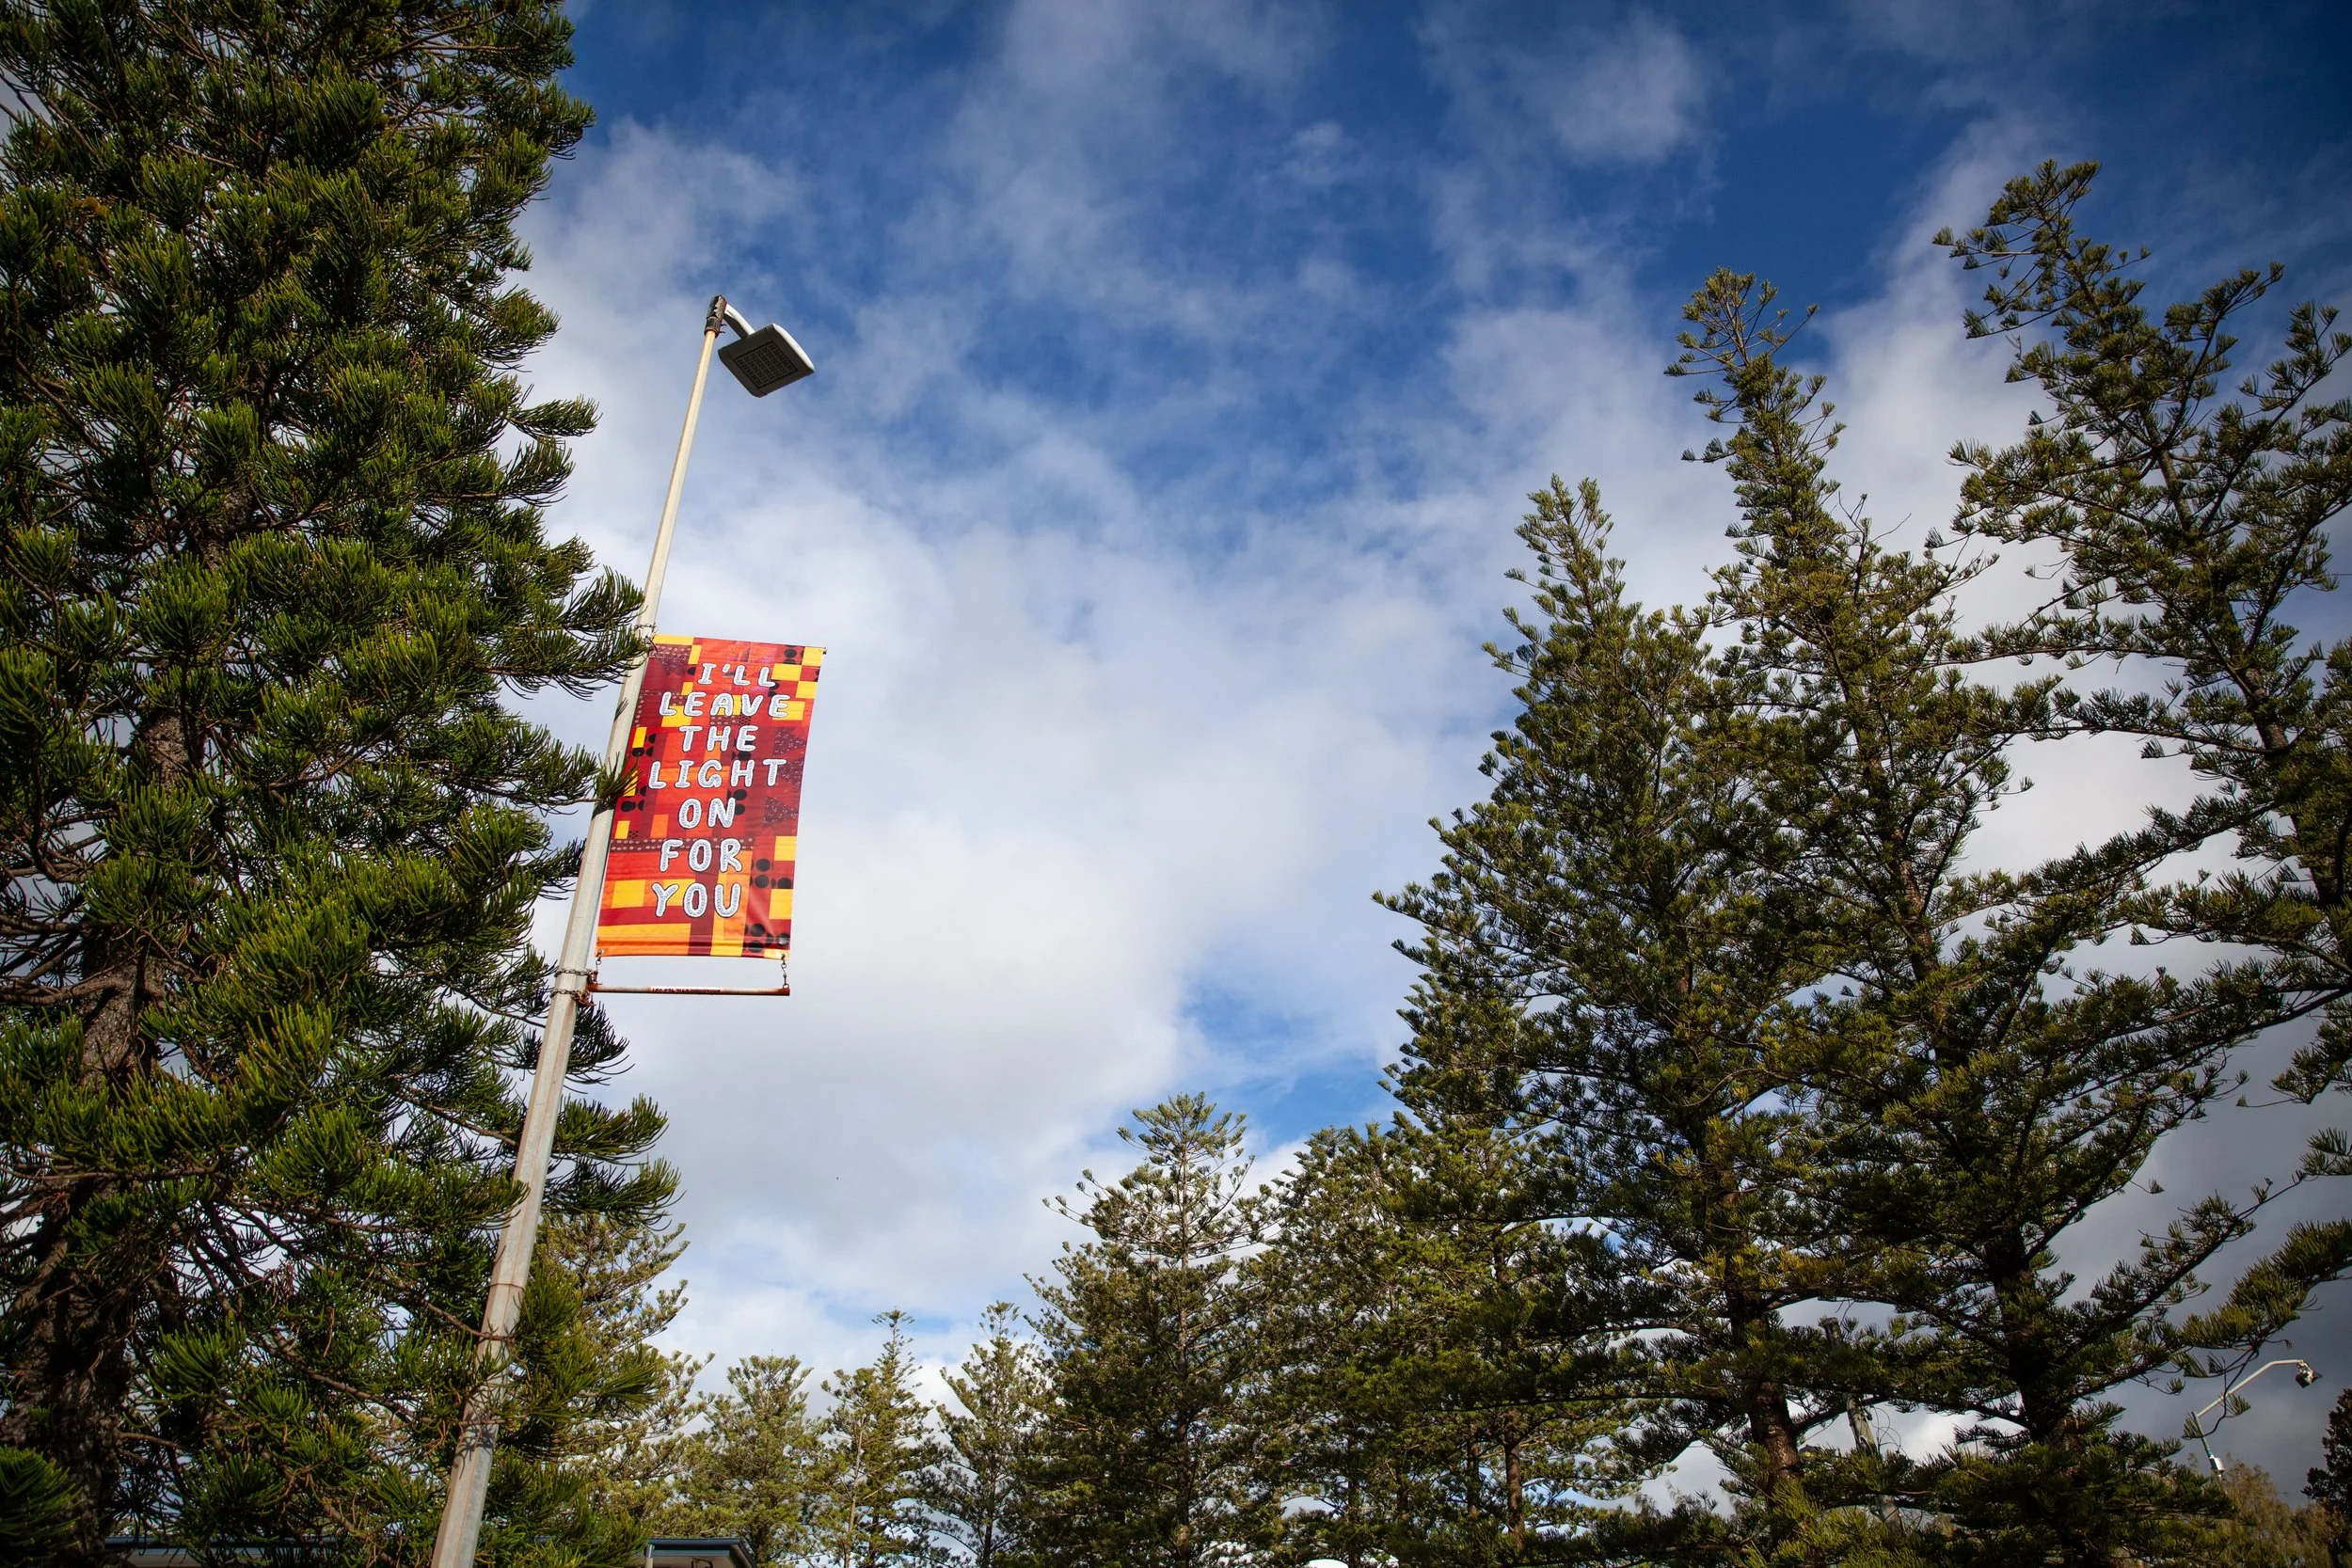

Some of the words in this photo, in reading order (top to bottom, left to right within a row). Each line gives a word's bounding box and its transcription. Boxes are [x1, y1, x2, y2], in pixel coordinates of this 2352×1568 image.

[697, 662, 775, 688] I'LL
[659, 692, 791, 718] LEAVE
[679, 725, 758, 752] THE
[648, 759, 786, 788] LIGHT
[678, 798, 736, 828] ON
[660, 839, 742, 872] FOR
[652, 883, 740, 918] YOU
